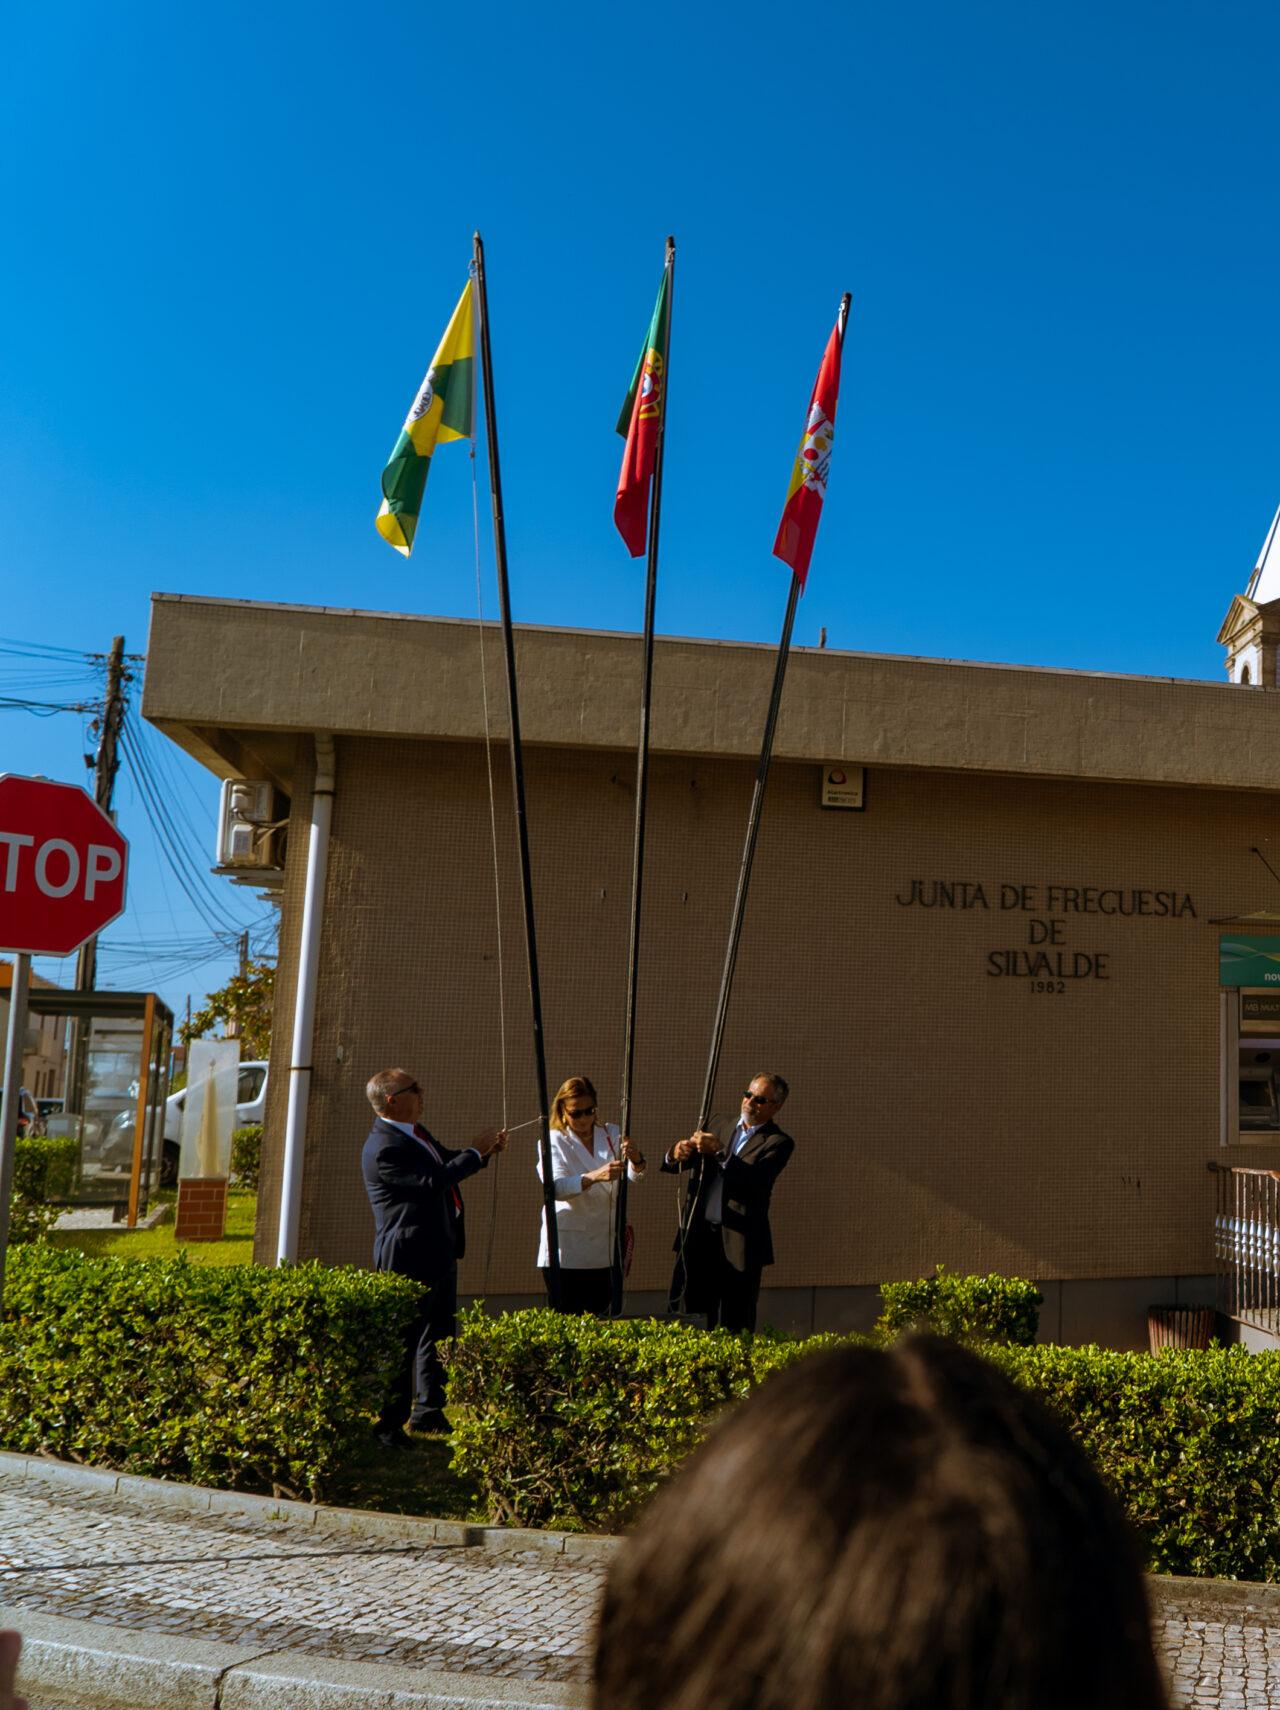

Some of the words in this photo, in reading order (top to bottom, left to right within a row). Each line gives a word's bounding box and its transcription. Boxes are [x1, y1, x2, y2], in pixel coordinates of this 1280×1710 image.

[0, 831, 122, 901] TOP
[896, 880, 990, 910] JUNTA
[1001, 884, 1038, 911] DE
[1047, 886, 1198, 918] FREGUESIA
[1028, 919, 1067, 945] DE
[986, 951, 1111, 980] SILVALDE
[1030, 980, 1067, 995] 1982
